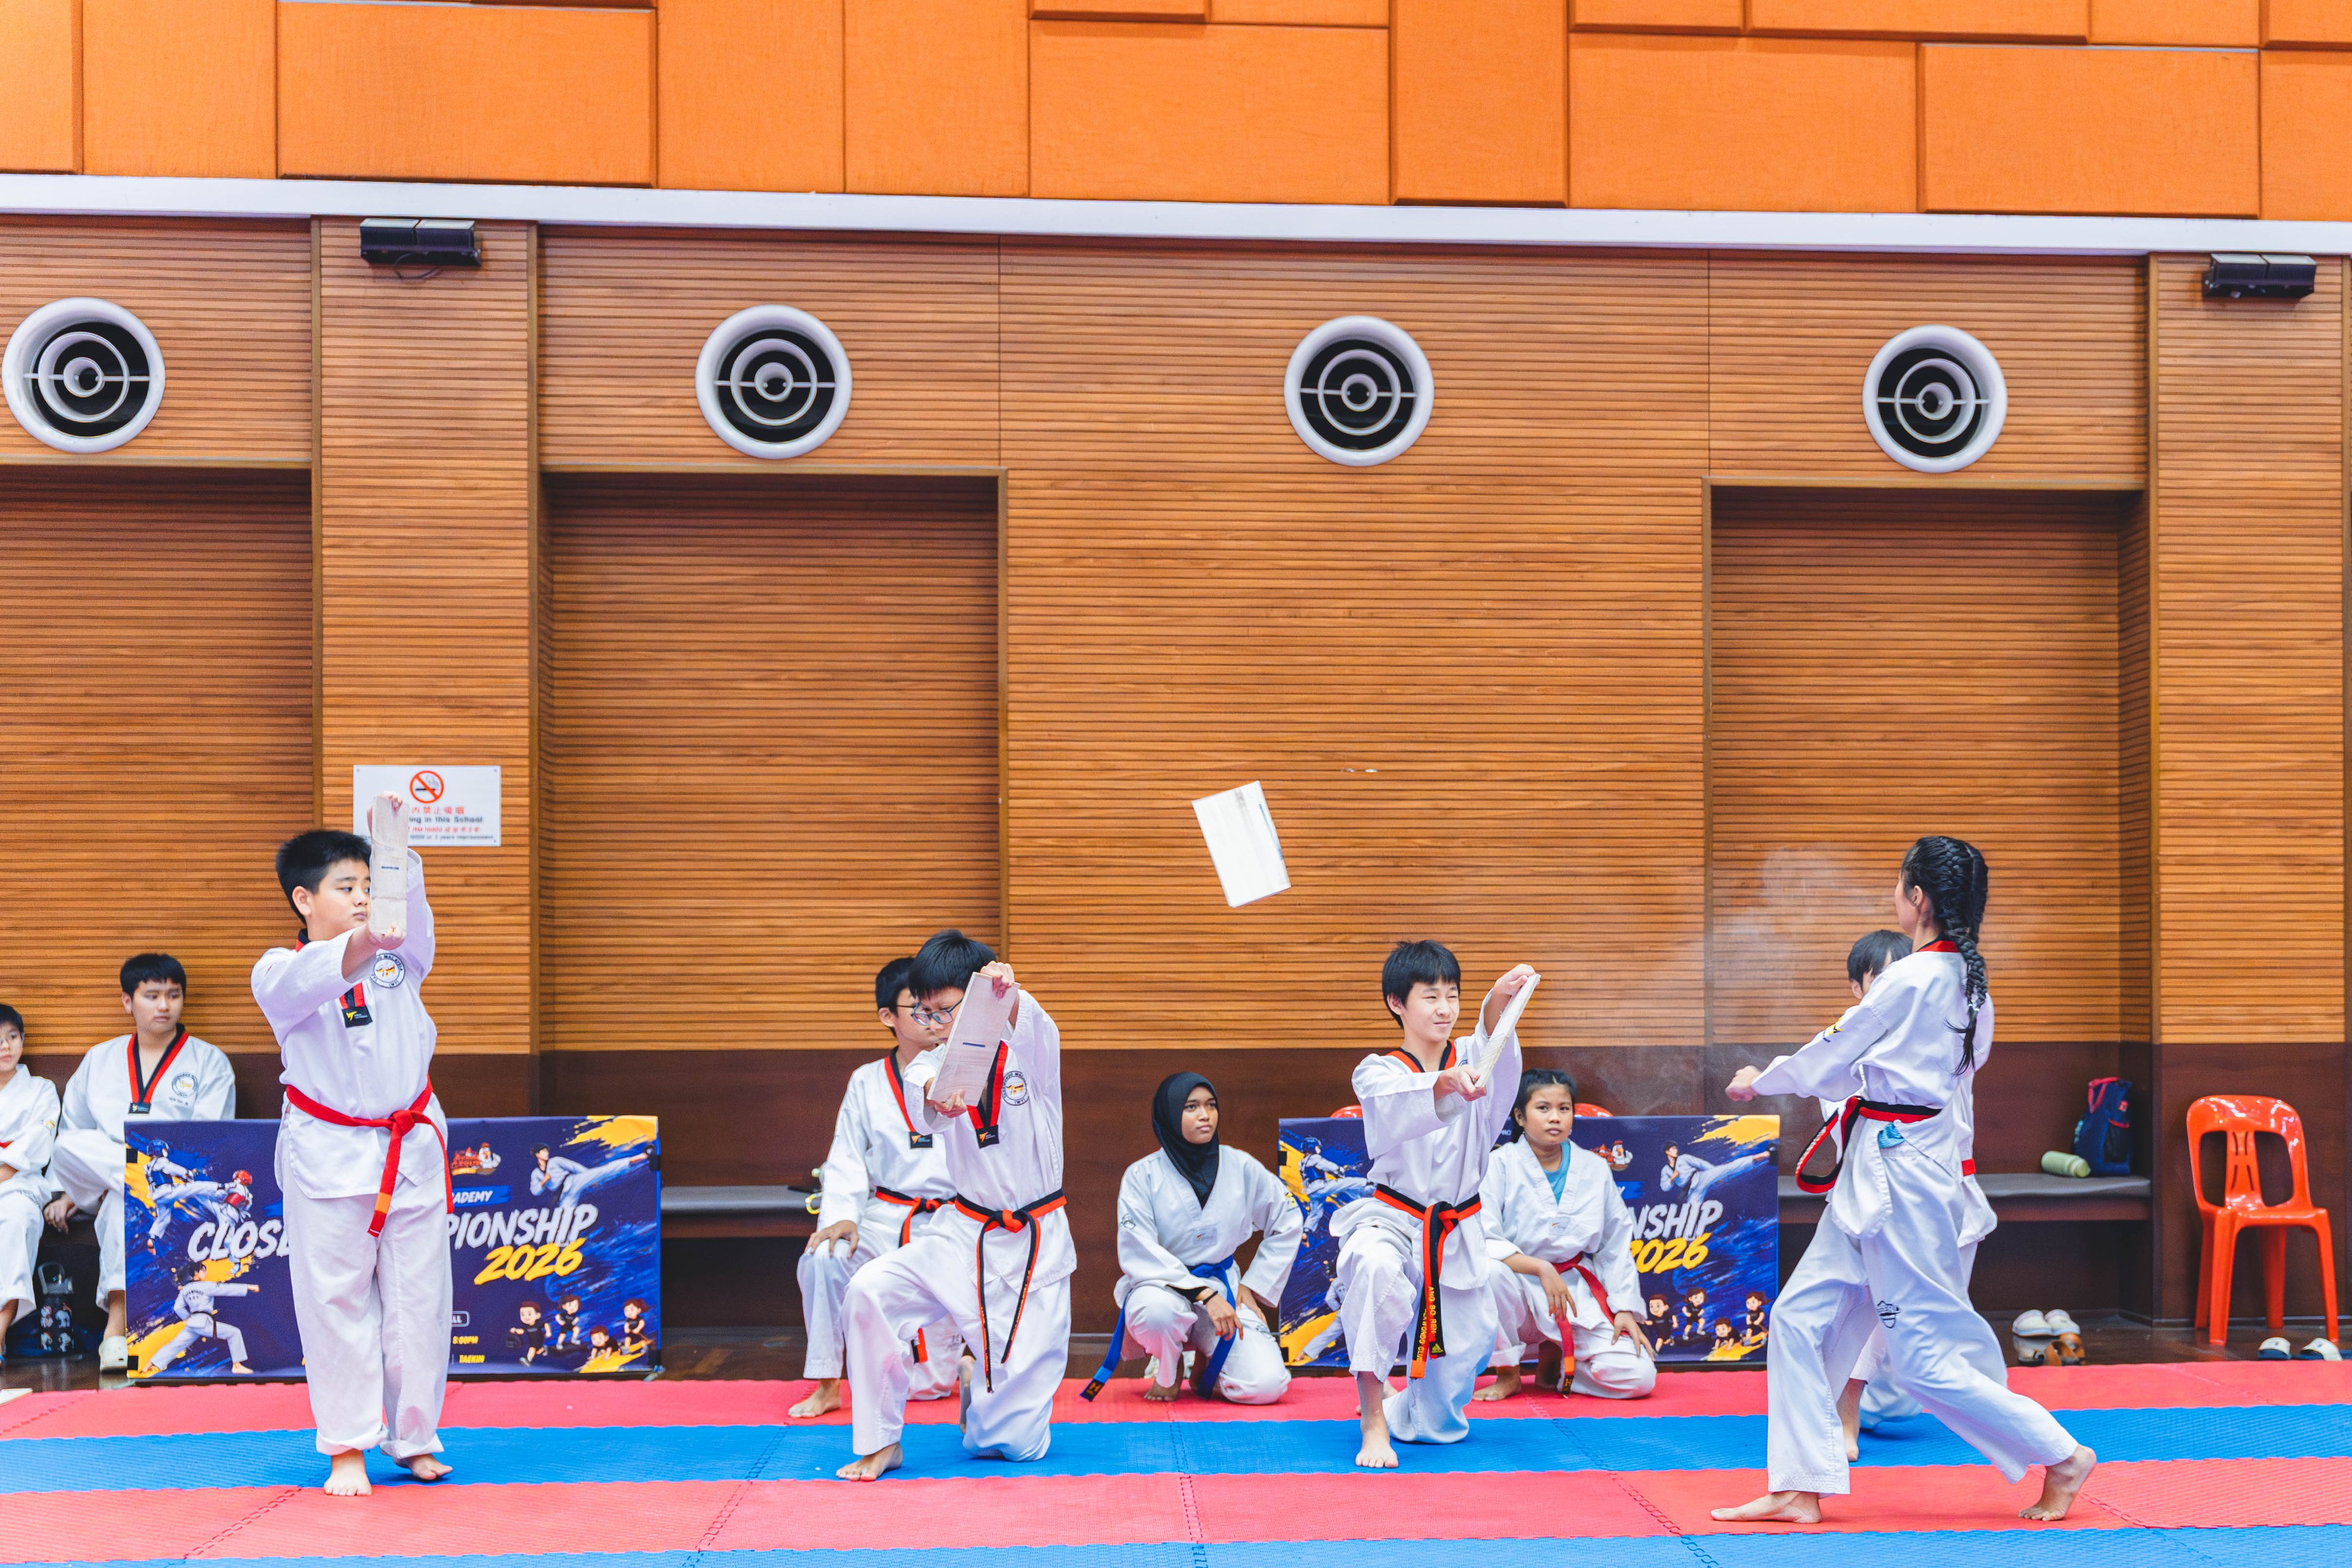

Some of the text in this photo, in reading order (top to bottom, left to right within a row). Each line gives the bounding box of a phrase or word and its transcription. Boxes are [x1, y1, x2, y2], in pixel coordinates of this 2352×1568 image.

[452, 1190, 493, 1204] ADEMY
[446, 1204, 598, 1250] PIONSHIP
[473, 1237, 586, 1285] 2026
[1430, 1305, 1436, 1316] BO
[1416, 1309, 1427, 1362] WONDO CLUB
